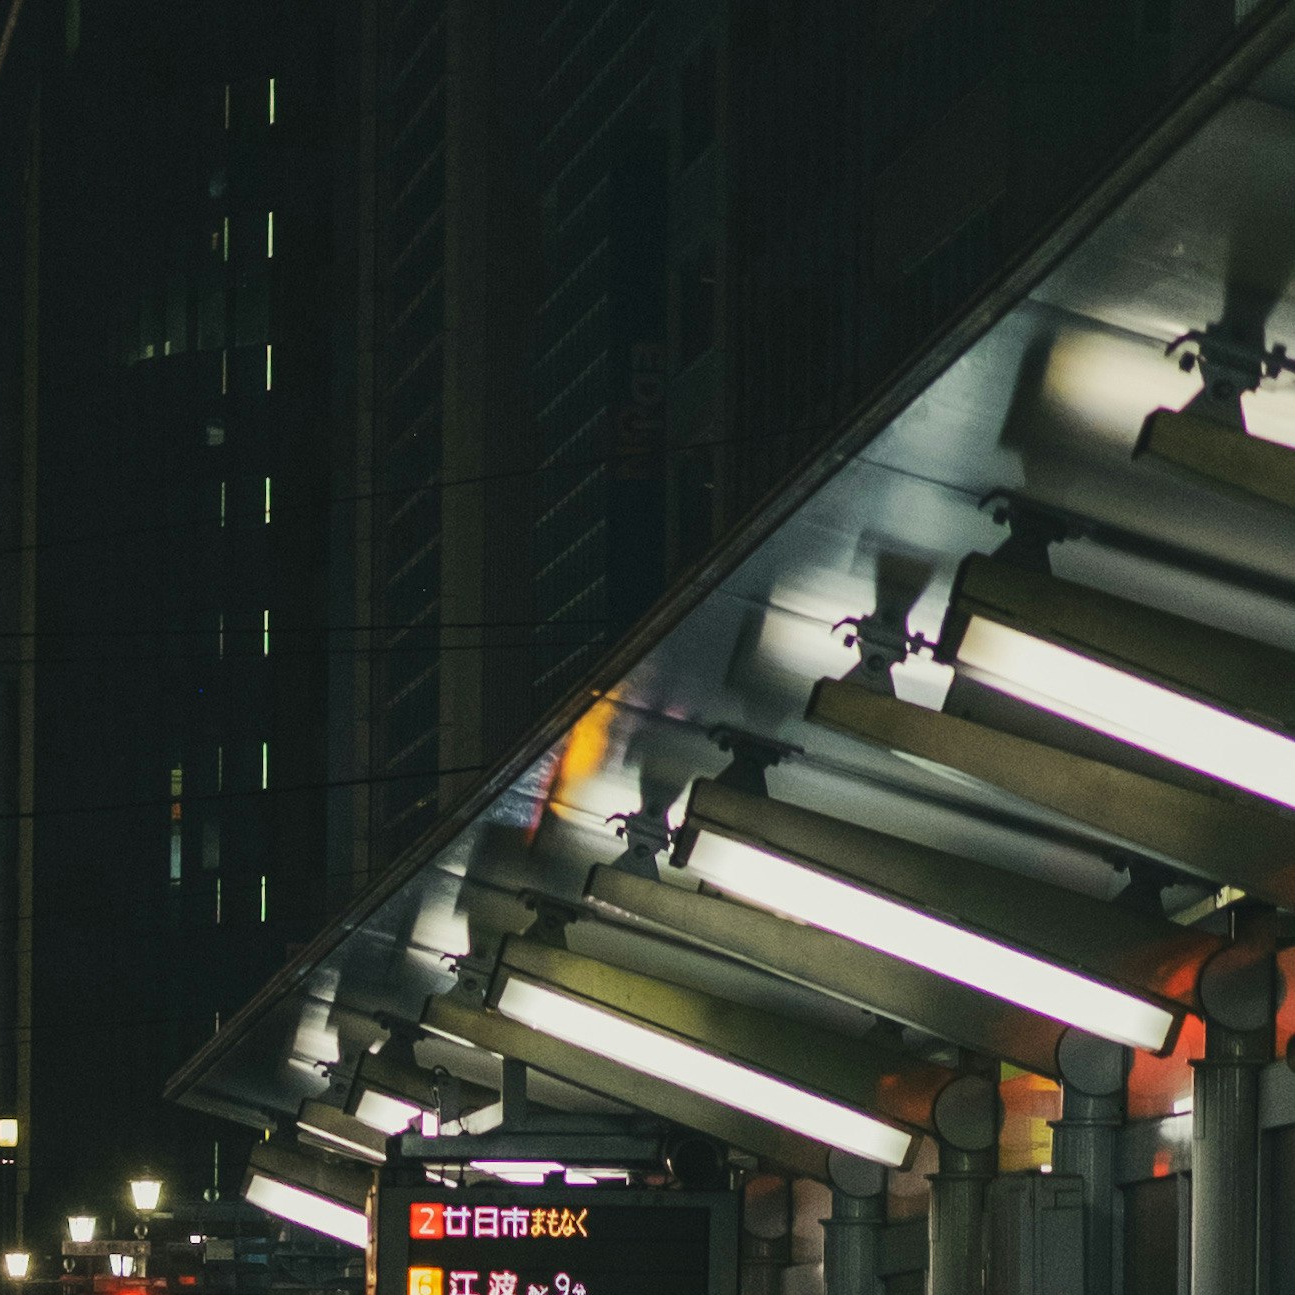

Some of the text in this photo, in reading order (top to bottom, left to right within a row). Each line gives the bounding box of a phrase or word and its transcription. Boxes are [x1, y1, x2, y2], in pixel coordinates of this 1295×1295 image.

[418, 1206, 588, 1238] 2 廿日市 まもなく
